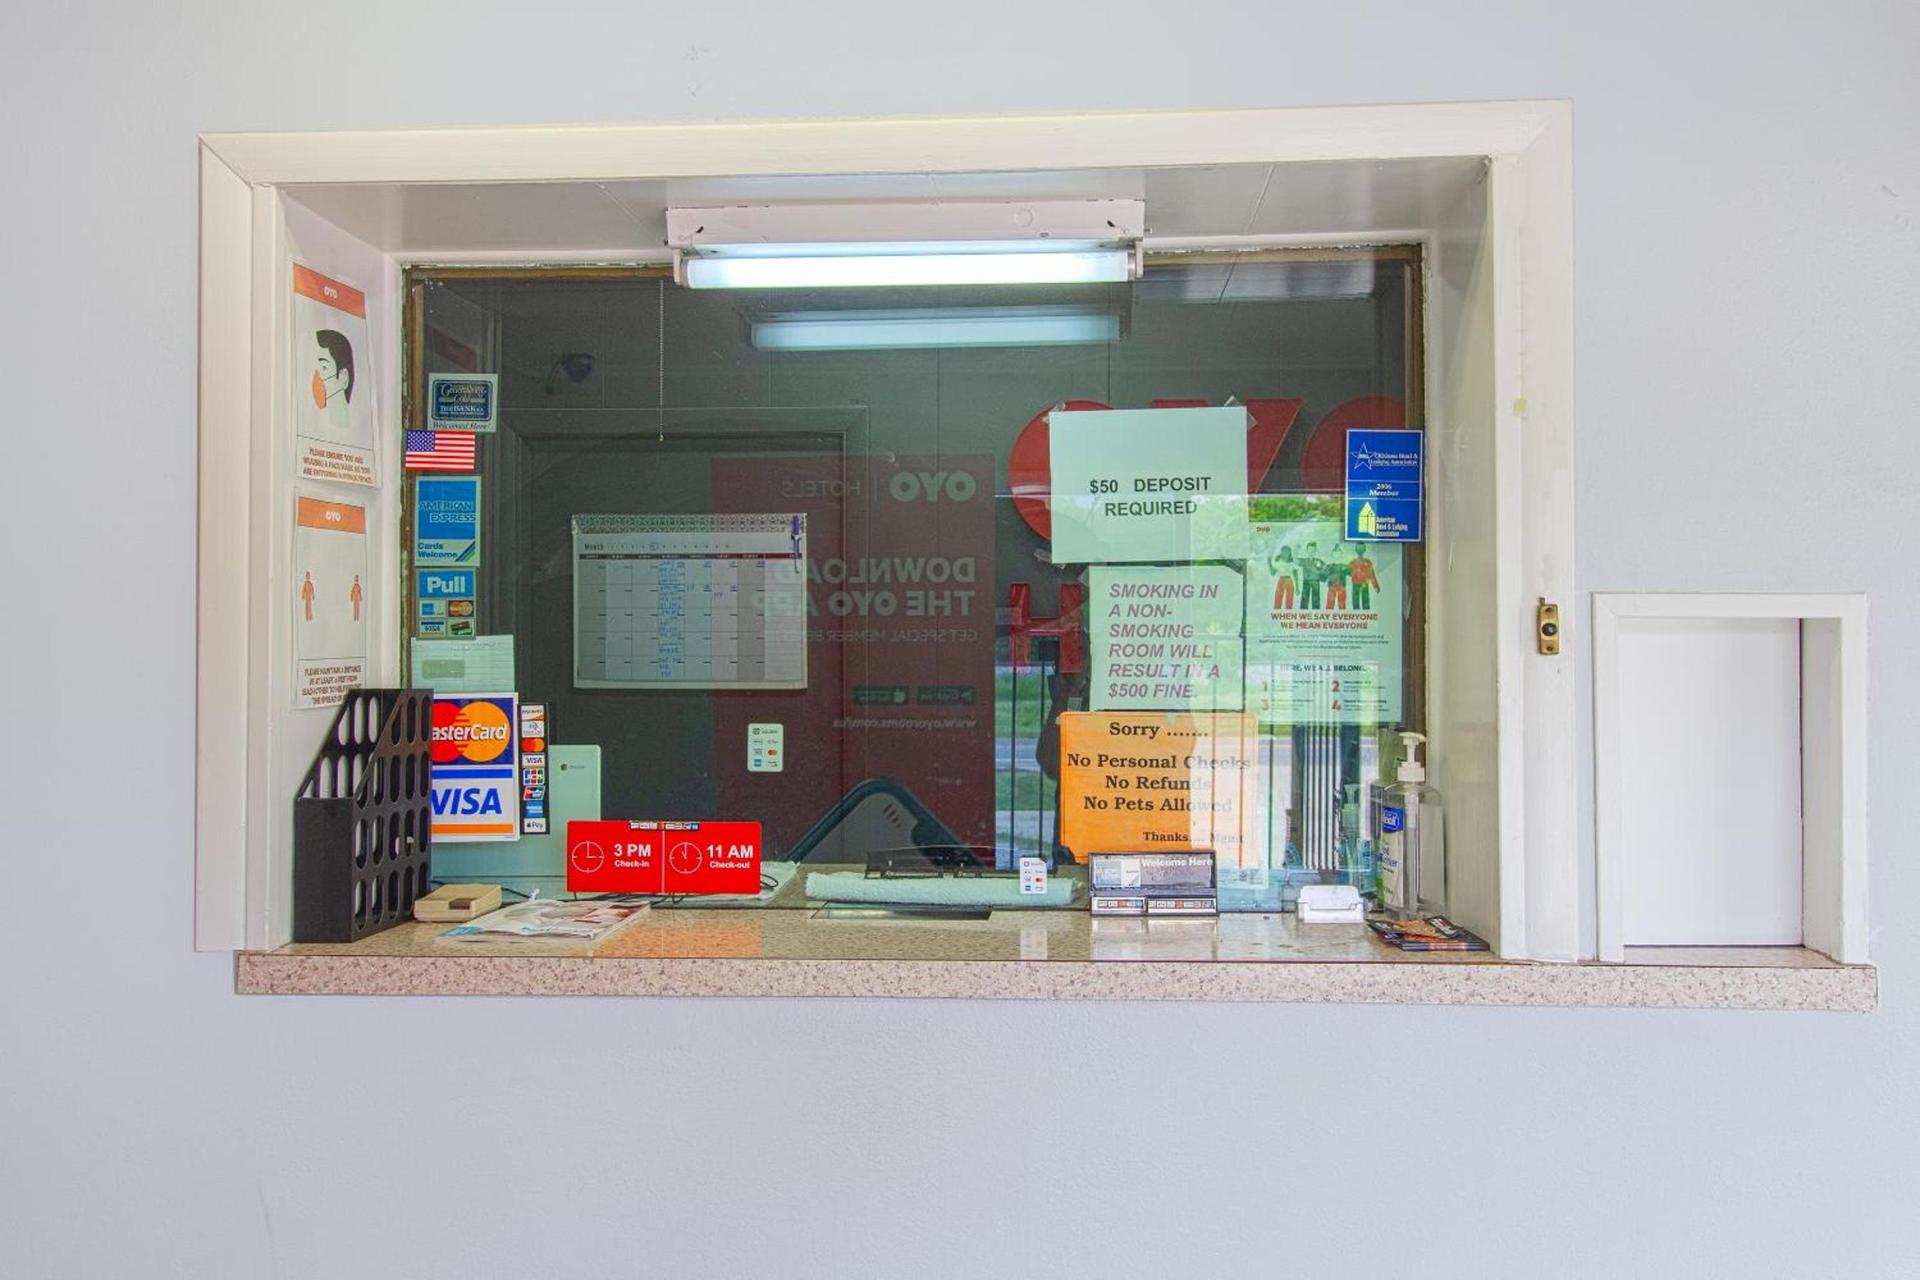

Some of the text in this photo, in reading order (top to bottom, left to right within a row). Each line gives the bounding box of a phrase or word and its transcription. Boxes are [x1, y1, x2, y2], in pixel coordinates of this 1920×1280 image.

[1090, 477, 1212, 494] $50 DEPOSIT
[420, 501, 472, 512] AMERICAN
[1104, 500, 1198, 516] REQUIRED
[326, 511, 342, 522] OYO
[430, 513, 477, 523] EXPRESS
[418, 542, 444, 550] Cards
[418, 552, 458, 560] Welcome
[427, 576, 466, 593] Pull
[1109, 584, 1218, 598] SMOKING IN
[1108, 604, 1173, 618] A NON-
[1332, 613, 1378, 621] EVERYONE
[1109, 624, 1194, 638] SMOKING
[1281, 622, 1368, 630] WE MEAN EVERYONE
[1109, 644, 1212, 658] ROOM WILL
[1108, 663, 1182, 678] RESULT
[1208, 664, 1220, 678] A
[1108, 682, 1149, 699] $500
[1332, 680, 1340, 692] 2
[1261, 699, 1270, 710] 3
[1332, 700, 1342, 711] 4
[432, 721, 508, 743] asterCard
[1110, 722, 1161, 740] Sorry
[1068, 754, 1250, 770] No Personal Checks
[1106, 776, 1129, 789] No
[432, 787, 502, 815] VISA
[1084, 796, 1108, 810] No
[1114, 796, 1154, 811] Pets
[614, 843, 651, 857] 3 PM
[706, 844, 754, 858] 11 AM
[614, 860, 650, 868] Check-in
[710, 860, 750, 868] Check-out
[1141, 857, 1214, 868] Welcome Here
